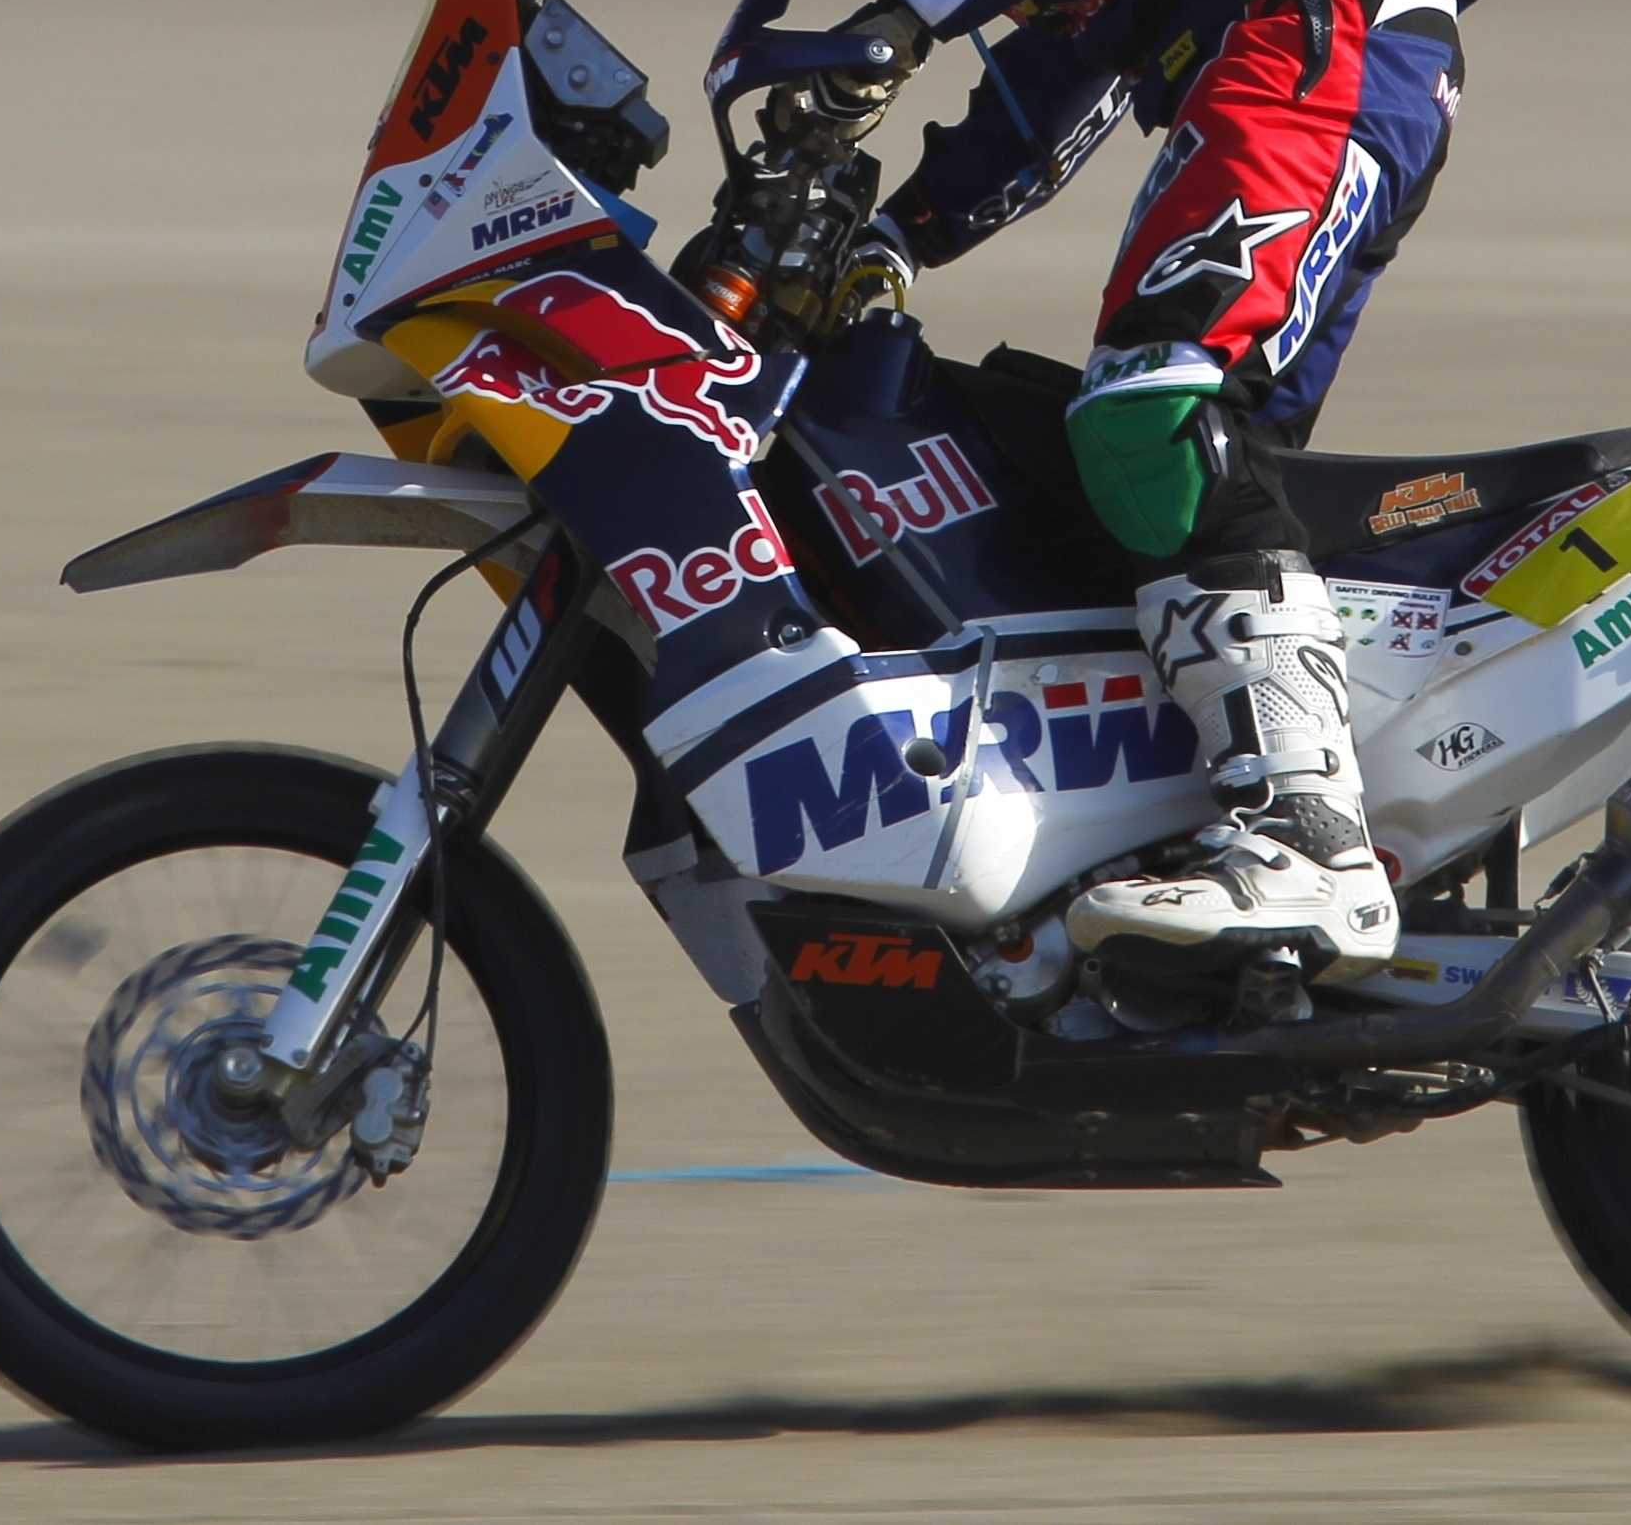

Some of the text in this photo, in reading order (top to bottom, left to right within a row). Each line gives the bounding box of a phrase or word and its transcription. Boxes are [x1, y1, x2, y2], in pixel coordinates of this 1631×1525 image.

[409, 15, 489, 144] KTM
[471, 190, 576, 251] MRW
[1278, 151, 1371, 364] MRW
[1378, 471, 1465, 515] KTM
[604, 432, 998, 639] Red Bull
[1470, 491, 1603, 584] TOTAL
[1558, 526, 1619, 574] 1
[1335, 585, 1369, 595] SAFETY
[745, 675, 1199, 877] MRW
[1438, 726, 1475, 766] HG
[791, 933, 943, 989] KTM
